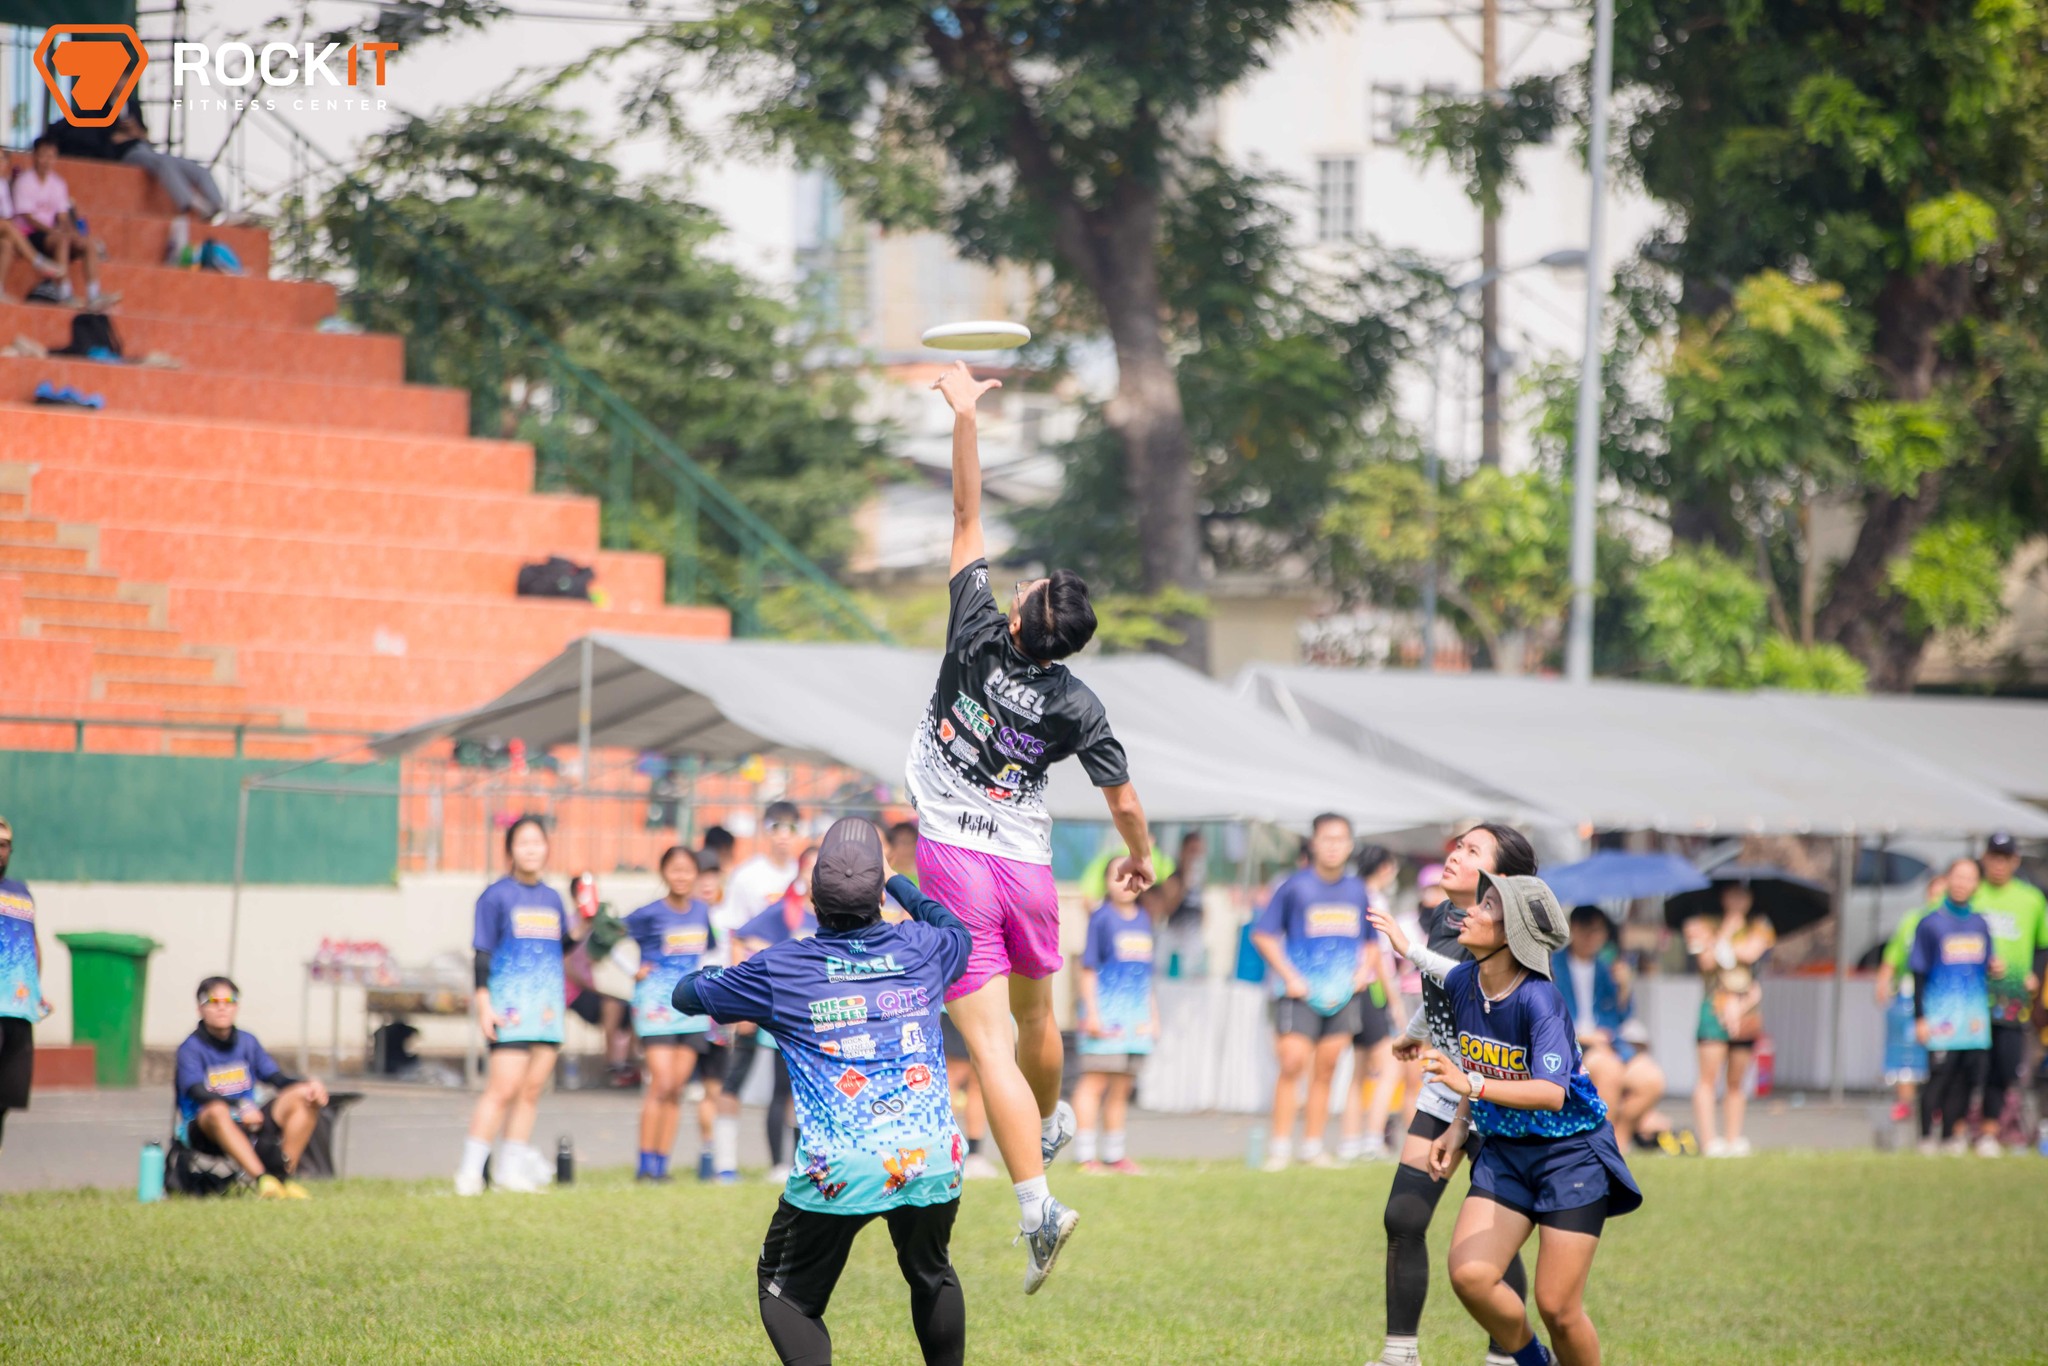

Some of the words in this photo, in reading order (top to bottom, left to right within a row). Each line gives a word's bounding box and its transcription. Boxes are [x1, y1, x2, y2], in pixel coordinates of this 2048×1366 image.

[958, 690, 979, 714] THE
[987, 667, 1044, 716] PIXEL
[999, 726, 1046, 756] QTS
[827, 953, 904, 975] PIXEL
[809, 998, 838, 1015] THE
[877, 987, 930, 1012] QTS
[811, 1007, 868, 1025] STREET
[1460, 1034, 1525, 1071] SONIC
